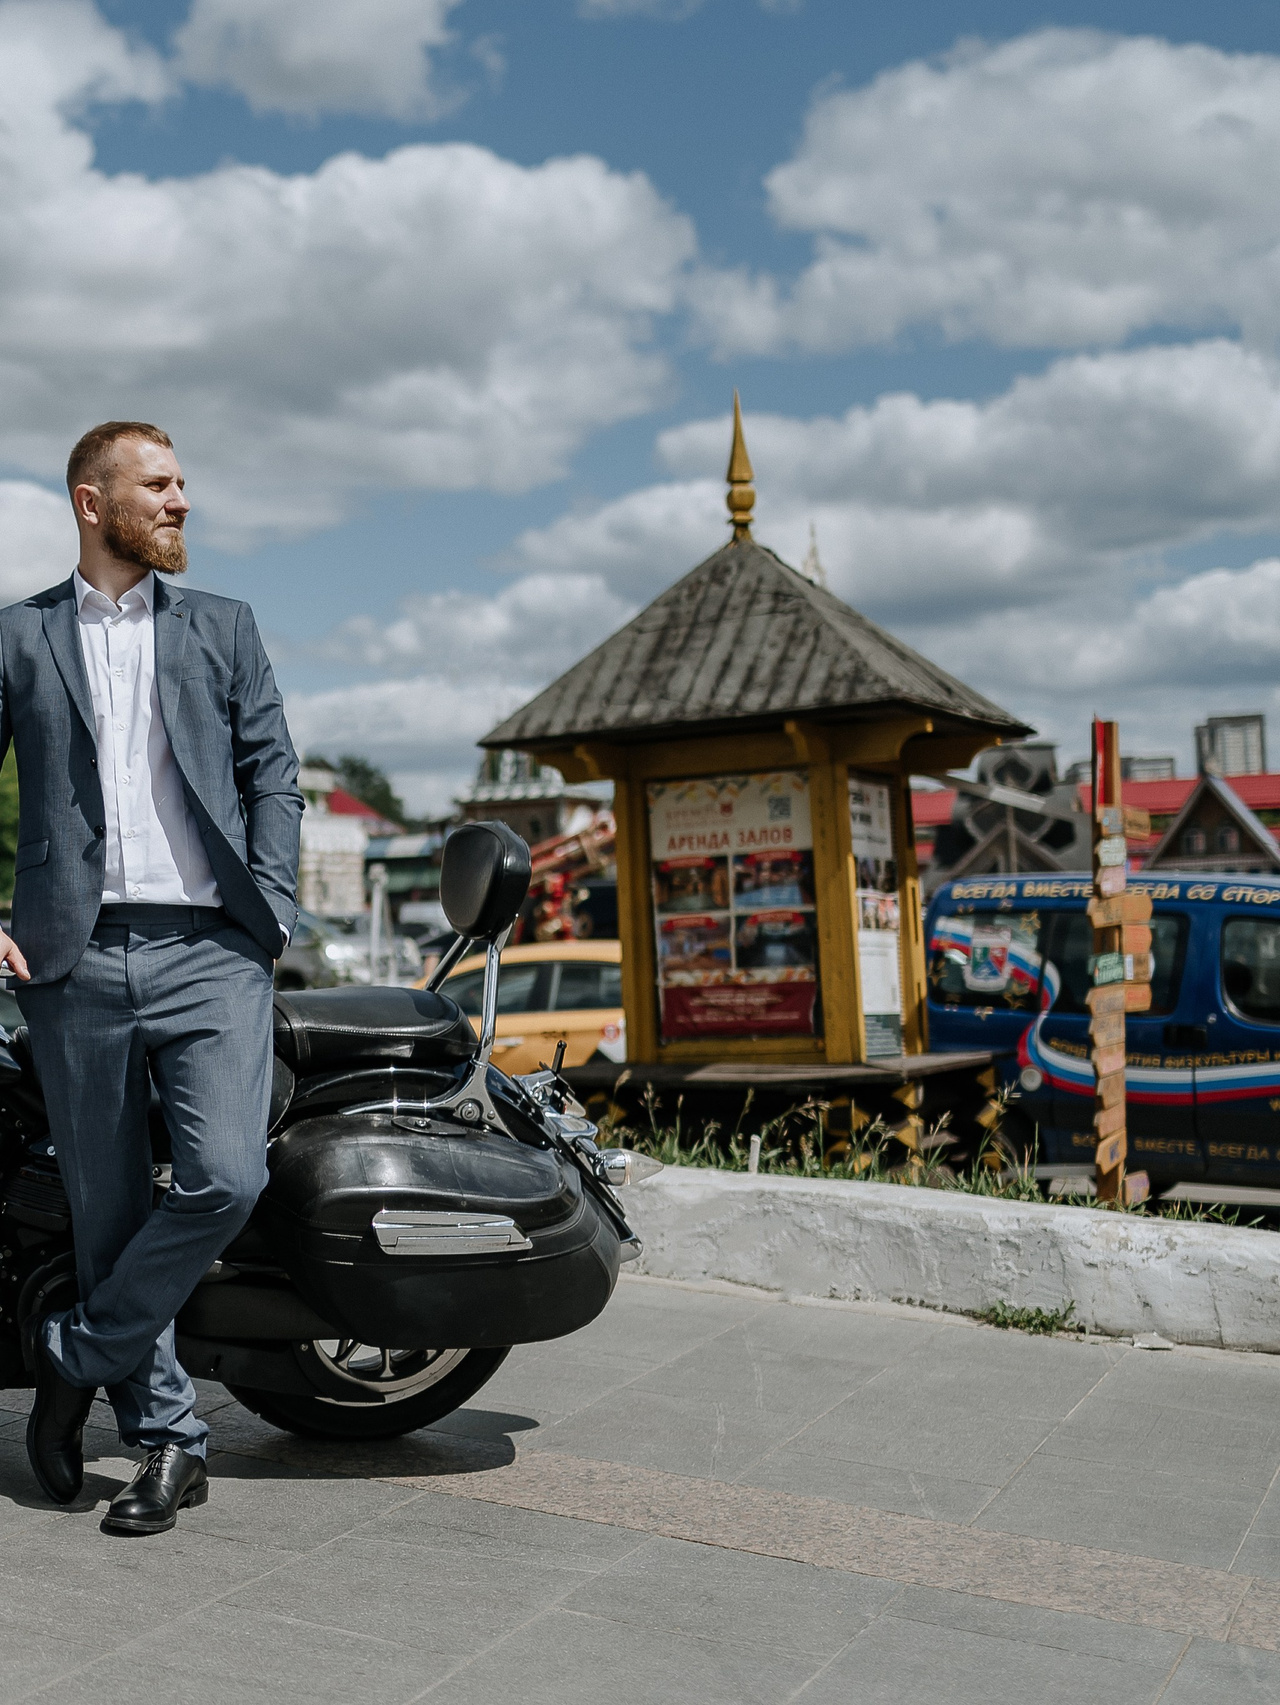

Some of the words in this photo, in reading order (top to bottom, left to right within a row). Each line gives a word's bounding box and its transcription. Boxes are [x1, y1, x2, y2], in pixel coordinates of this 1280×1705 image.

[667, 832, 730, 851] АРЕНДА
[738, 827, 793, 847] ЗАЛОВ
[951, 882, 1017, 899] ВСЕГДА
[1022, 882, 1093, 899] ВМЕСТЕ
[1186, 884, 1218, 900] СО
[1164, 1048, 1270, 1069] ФИЗКУЛЬТУРЫ
[1208, 1142, 1270, 1161] ВСЕГДА
